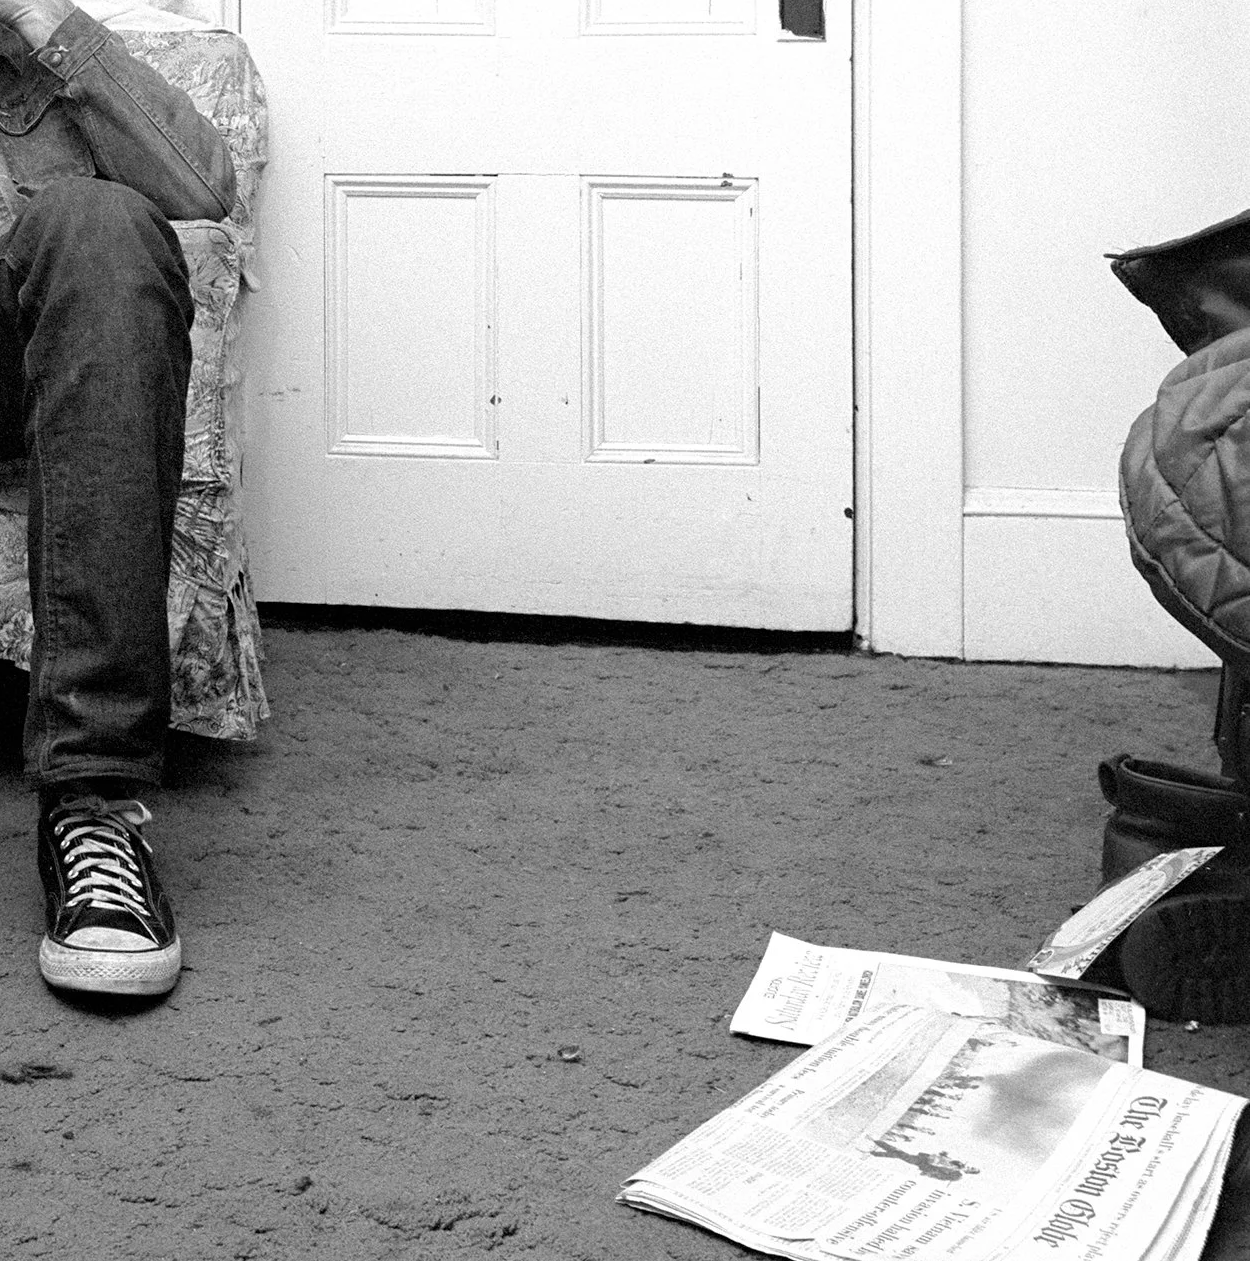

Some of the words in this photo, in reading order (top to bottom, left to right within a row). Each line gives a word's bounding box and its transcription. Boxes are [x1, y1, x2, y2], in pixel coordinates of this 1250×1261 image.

[765, 986, 810, 1031] Saturday
[809, 1047, 843, 1066] tuition
[791, 1067, 816, 1079] fees
[1120, 1096, 1168, 1130] The
[1074, 1134, 1146, 1197] Boston
[1142, 1156, 1161, 1177] start
[1137, 1179, 1147, 1189] as
[826, 1180, 916, 1245] counter-offensive
[899, 1190, 951, 1224] invasion
[959, 1199, 979, 1207] S.
[1117, 1191, 1140, 1220] owners
[866, 1223, 910, 1251] halted
[915, 1212, 969, 1245] Vietnam
[1033, 1199, 1096, 1248] Globe
[1096, 1222, 1119, 1246] reject
[849, 1247, 878, 1255] by
